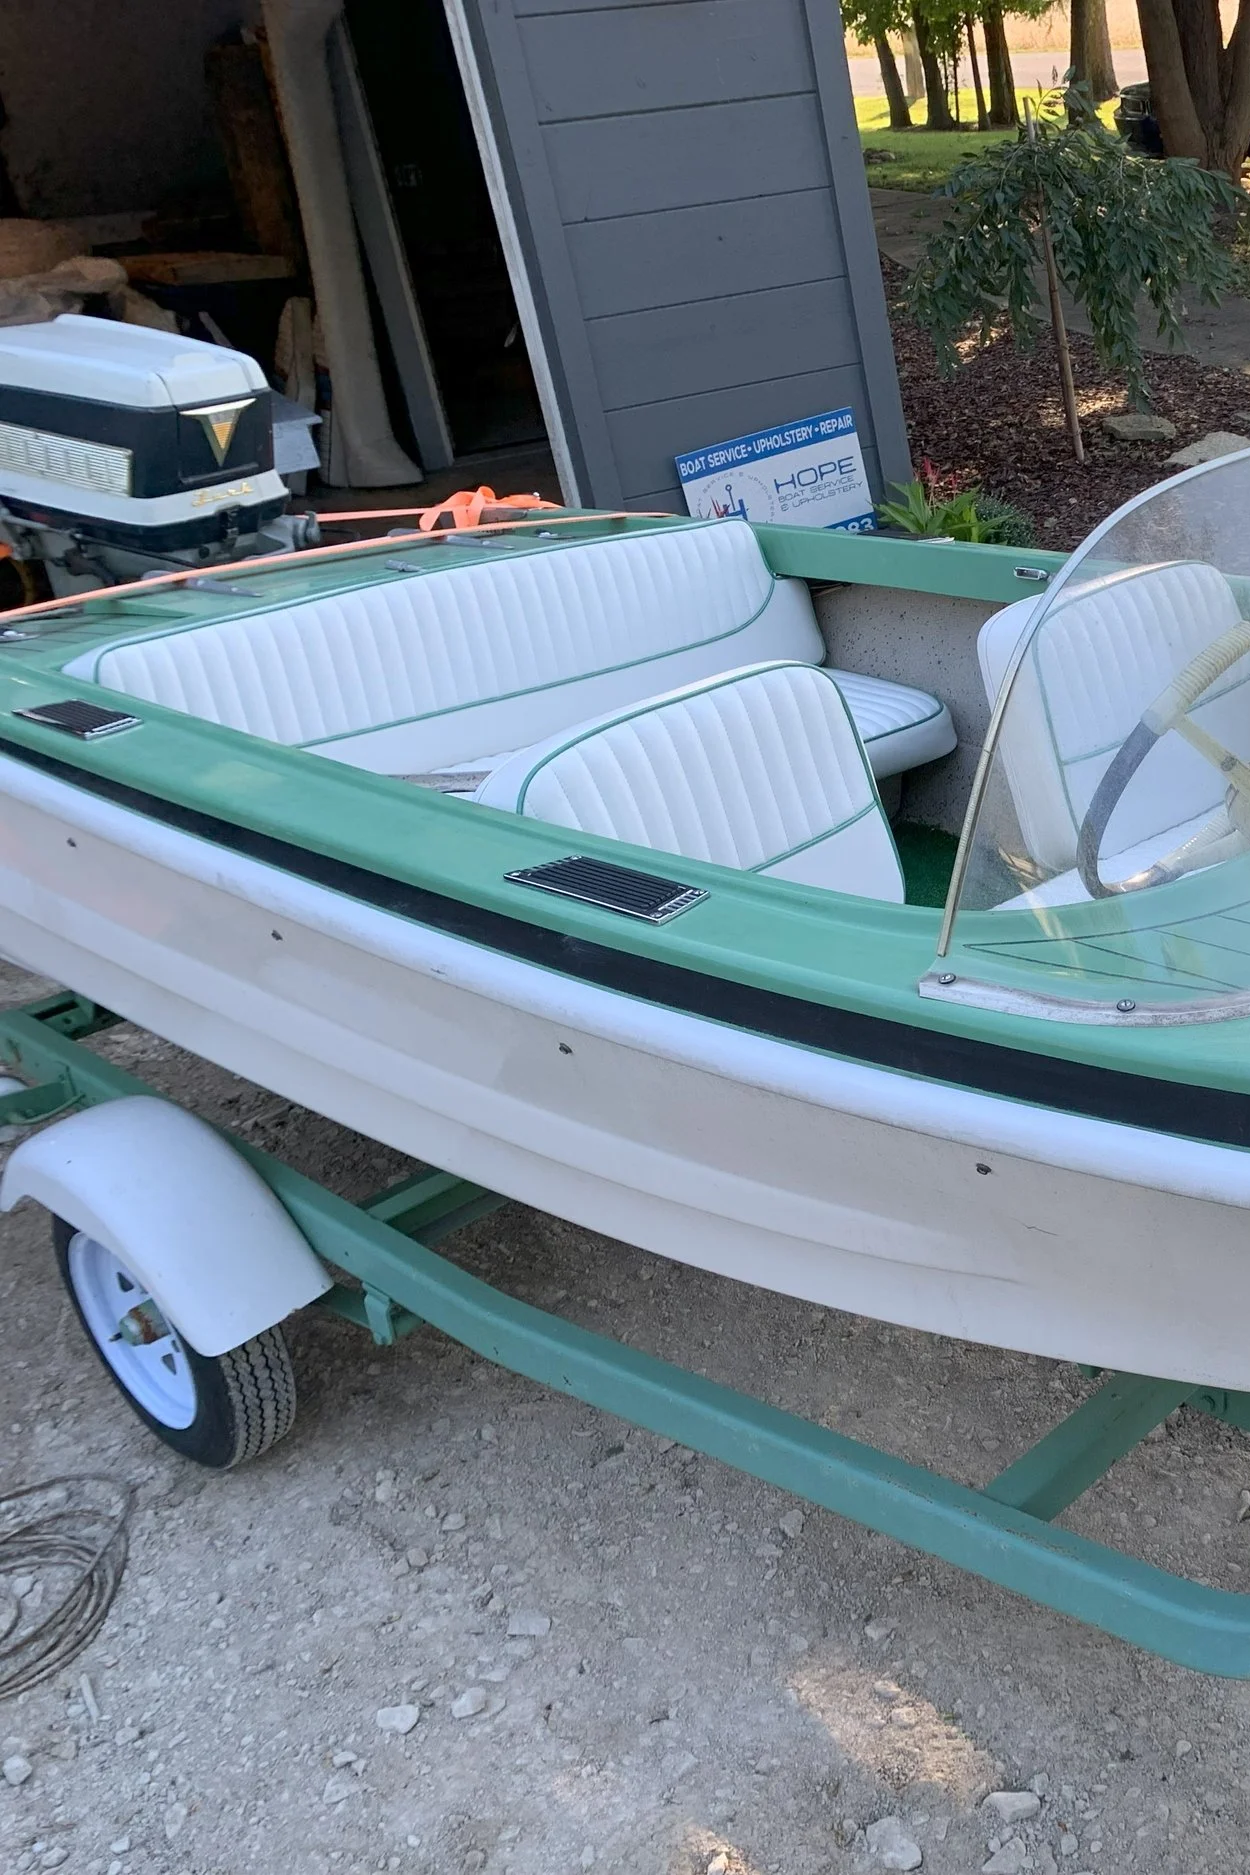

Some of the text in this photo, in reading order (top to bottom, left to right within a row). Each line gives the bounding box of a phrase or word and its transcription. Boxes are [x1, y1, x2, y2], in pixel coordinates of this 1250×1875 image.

[680, 414, 853, 477] BOAT SERVICE UPHOLSTERY REPAIR
[774, 456, 857, 494] HOPE
[778, 475, 855, 503] BOAT SERVICE
[792, 481, 864, 508] UPHOLSTERY
